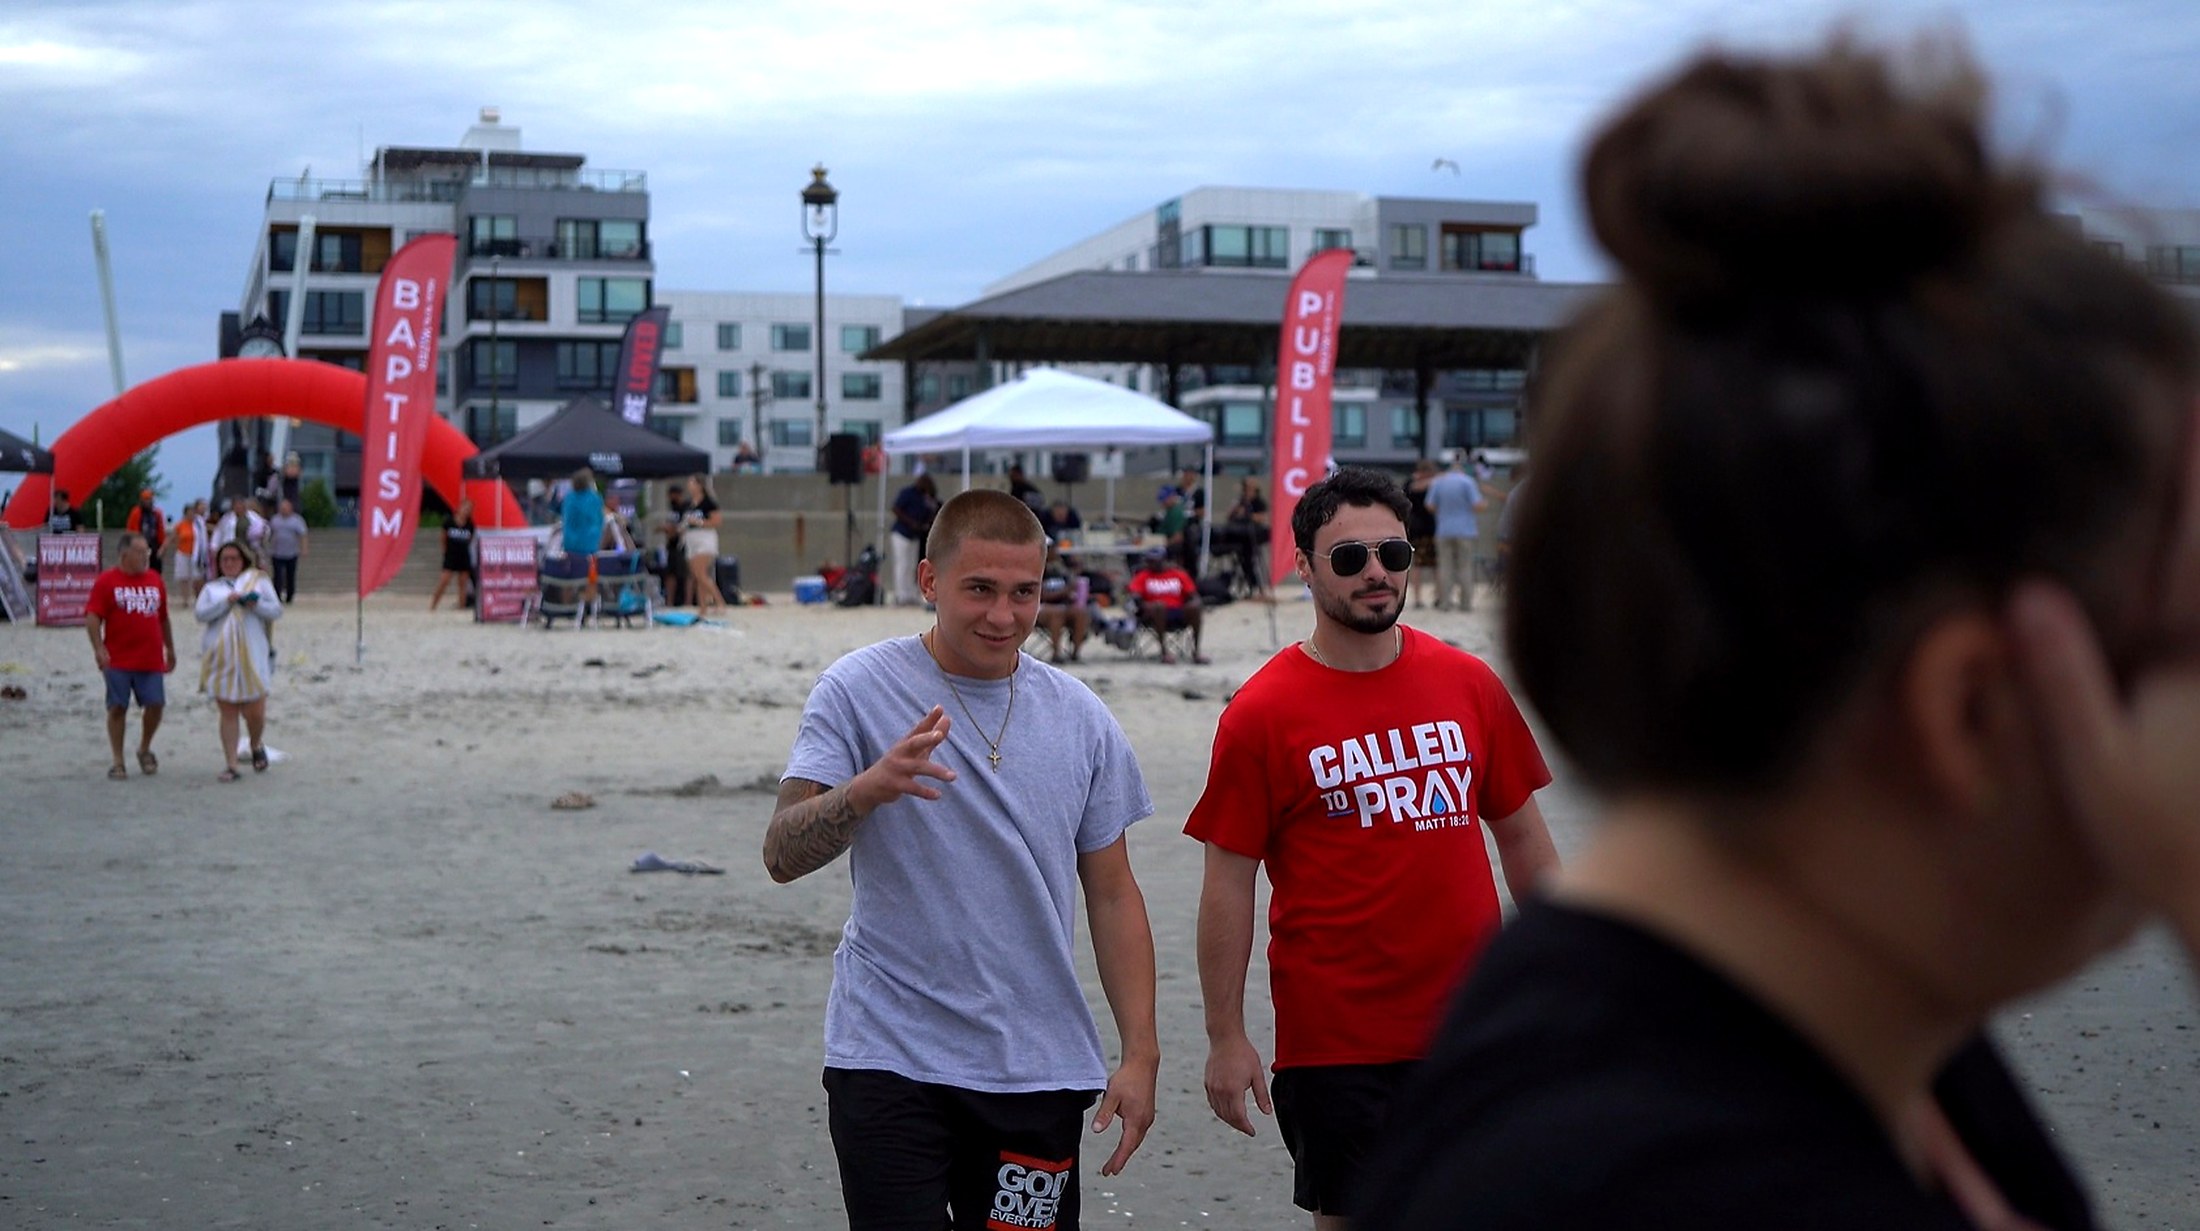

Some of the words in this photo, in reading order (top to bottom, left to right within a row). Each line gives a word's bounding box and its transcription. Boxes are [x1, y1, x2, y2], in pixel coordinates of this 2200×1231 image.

[627, 320, 658, 391] LOVED
[372, 278, 421, 538] BAPTISM
[1283, 290, 1323, 497] PUBLIC
[1321, 789, 1349, 811] TO
[1354, 766, 1472, 828] PRAY
[1415, 816, 1446, 832] MATT
